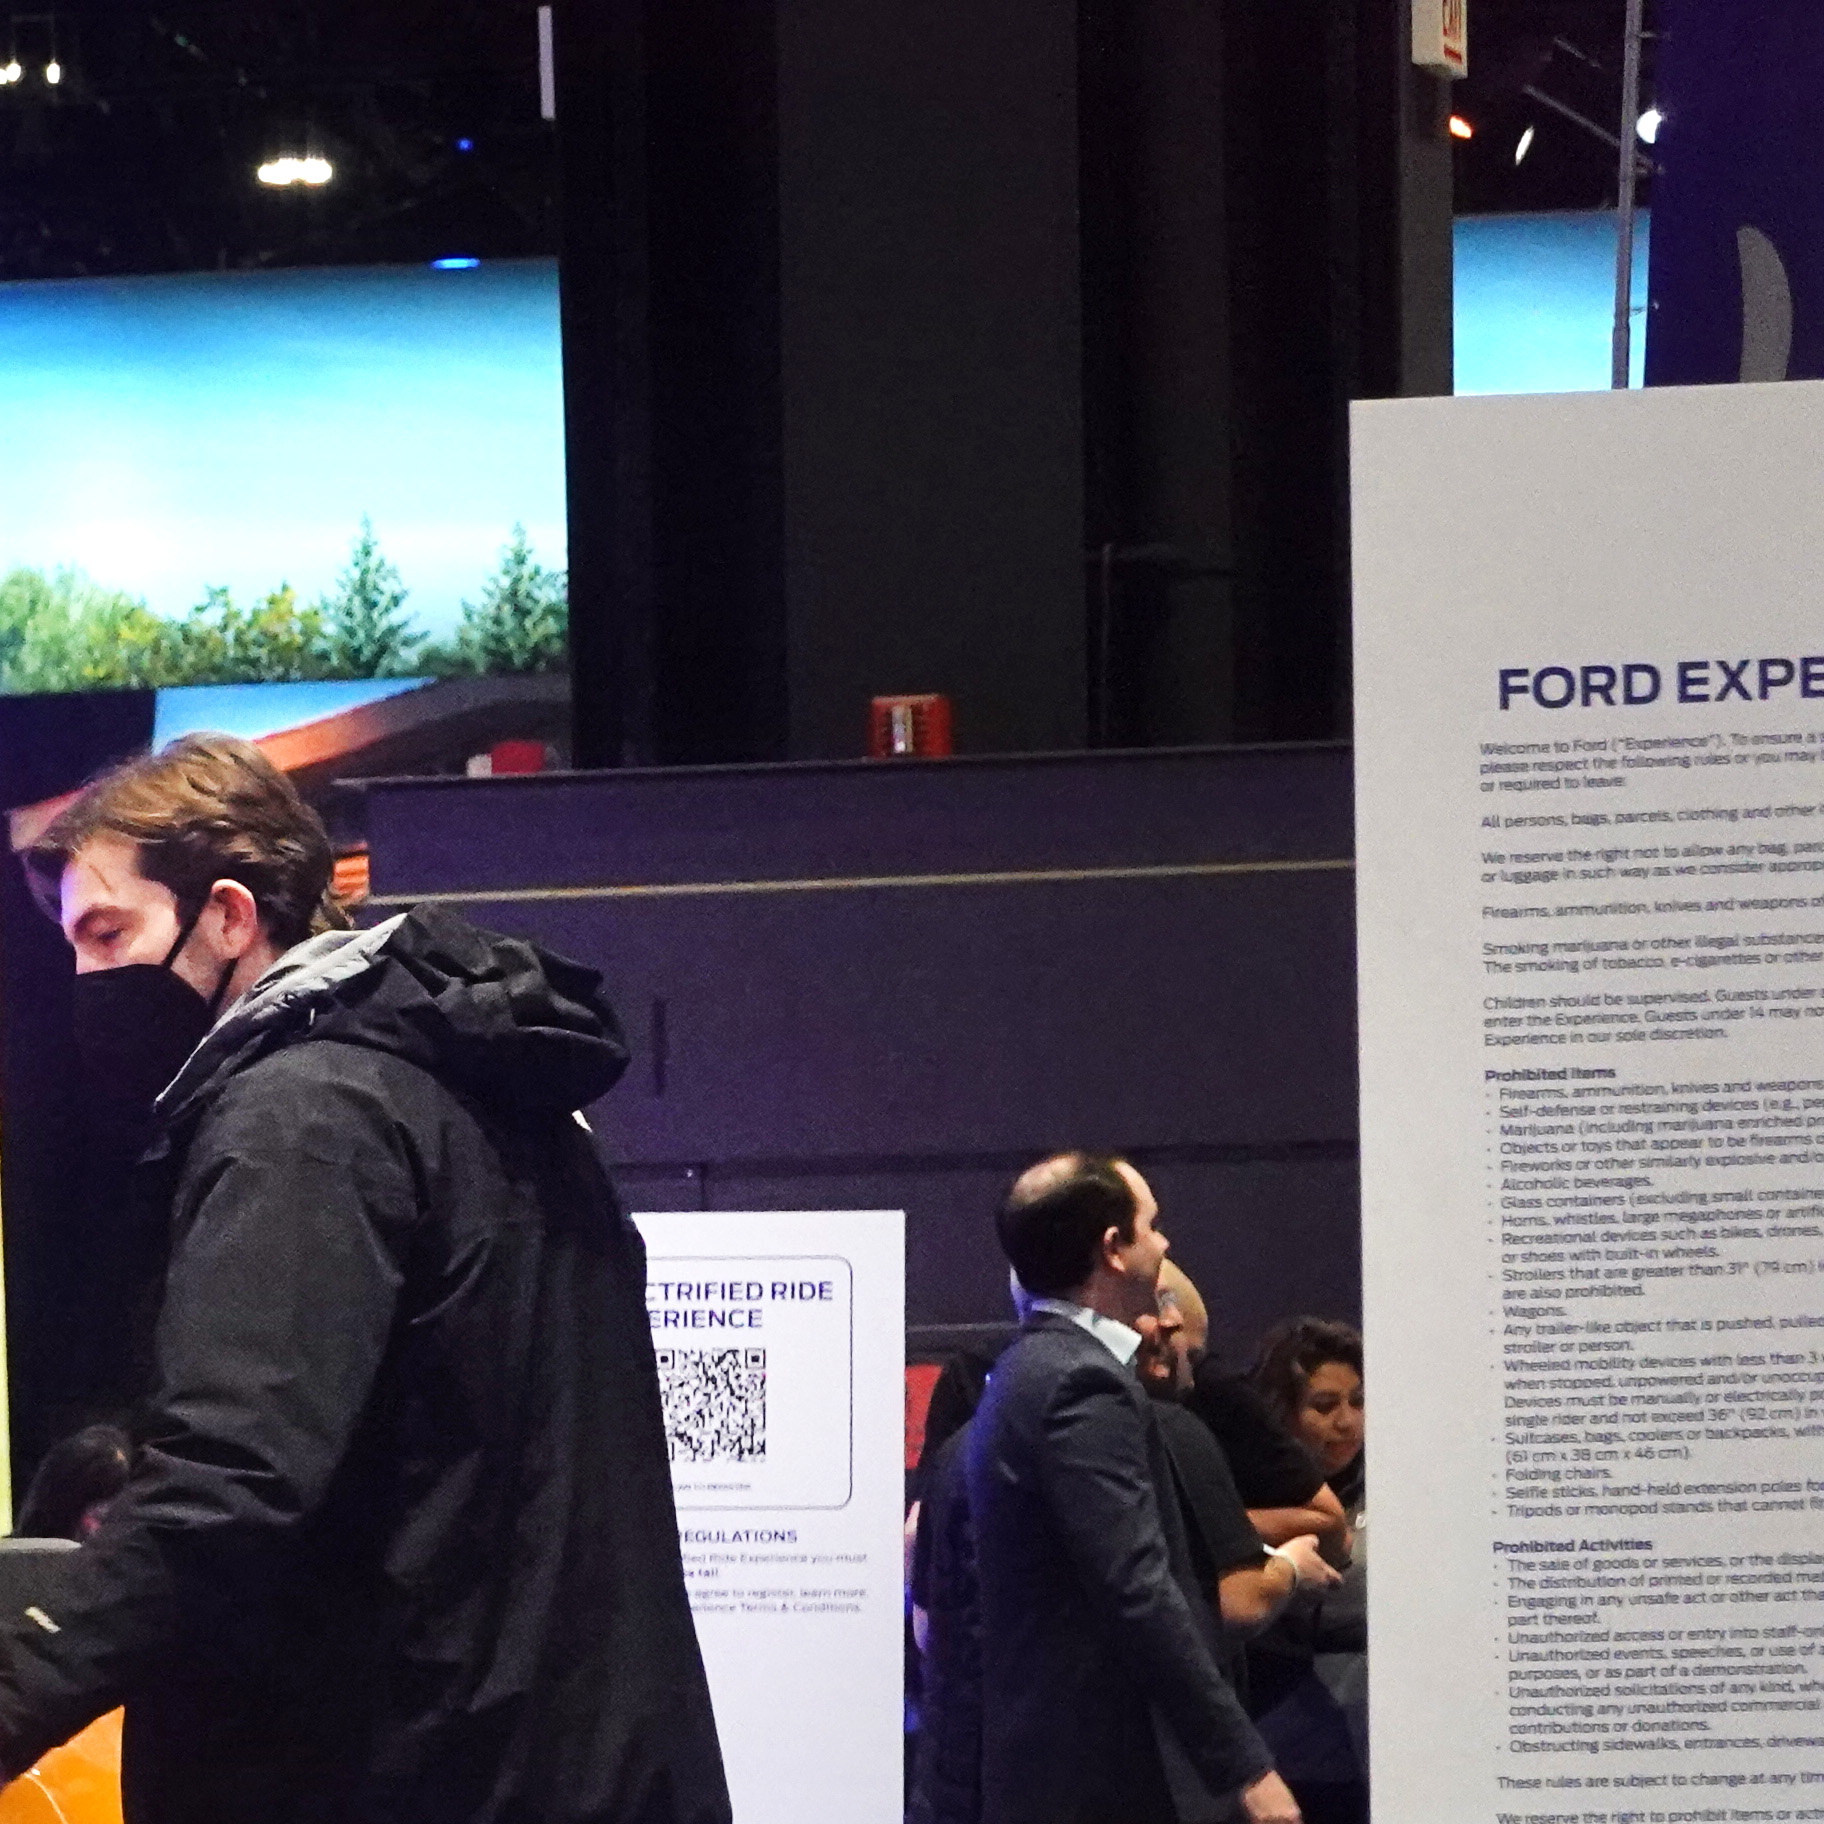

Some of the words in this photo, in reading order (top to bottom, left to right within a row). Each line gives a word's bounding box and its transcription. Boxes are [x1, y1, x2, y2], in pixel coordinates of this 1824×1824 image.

[1499, 663, 1662, 711] FORD
[770, 1280, 833, 1300] RIDE
[678, 1530, 798, 1544] EGULATIONS
